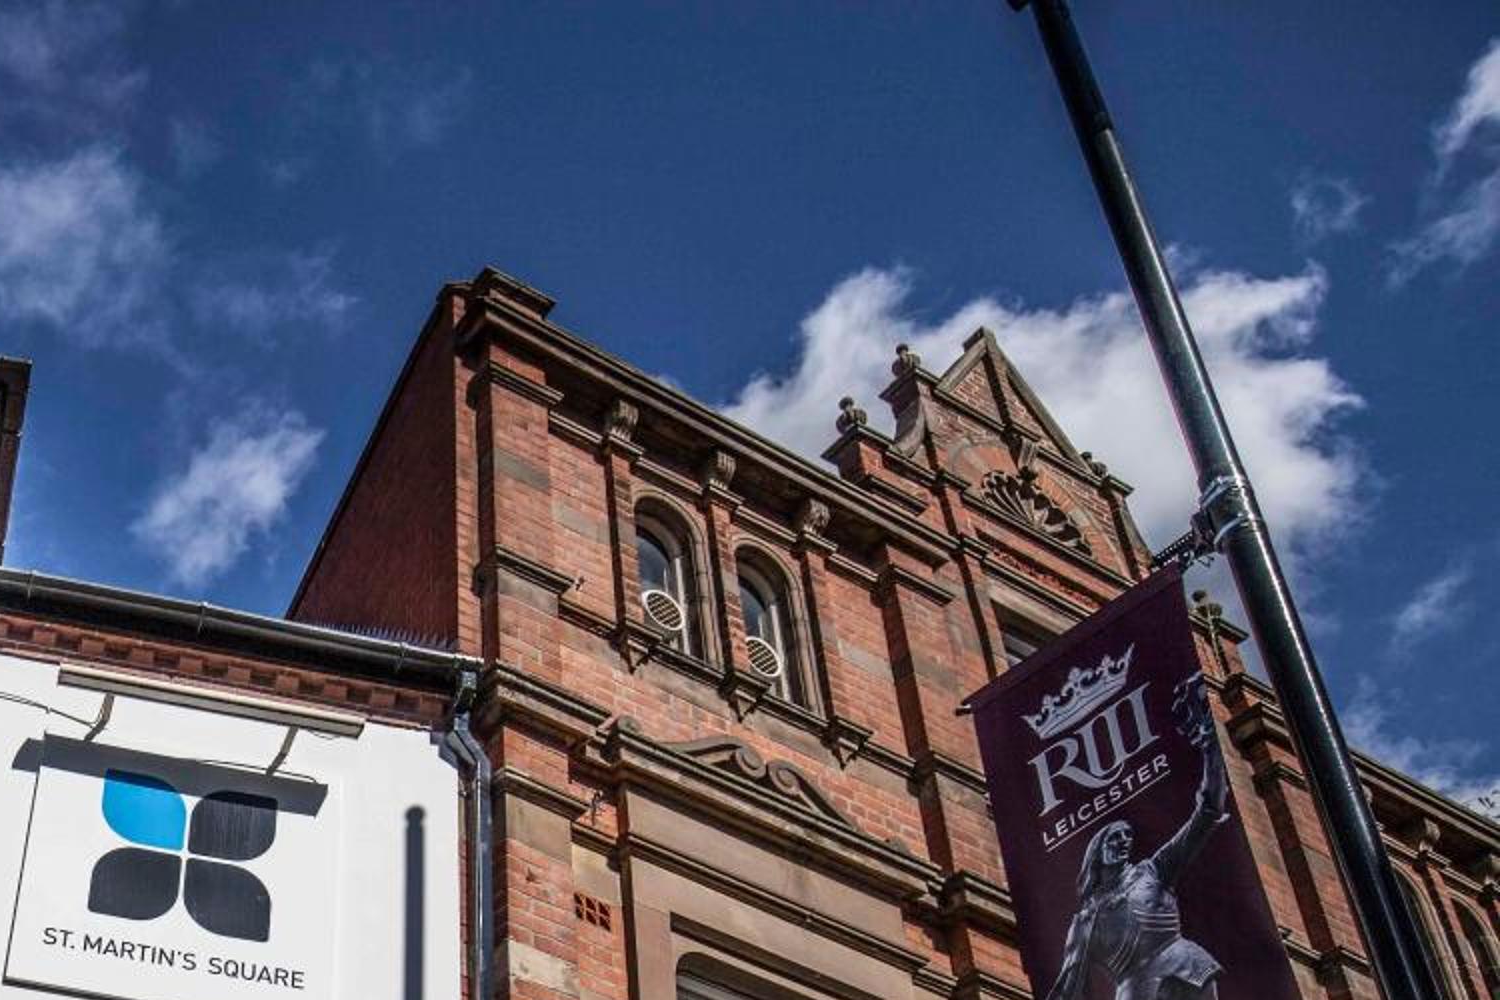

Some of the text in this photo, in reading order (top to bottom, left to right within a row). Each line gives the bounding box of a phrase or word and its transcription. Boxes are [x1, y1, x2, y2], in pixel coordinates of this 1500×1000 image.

[1042, 753, 1169, 847] LEICESTER
[42, 926, 305, 990] ST. MARTIN'S SQUARE
